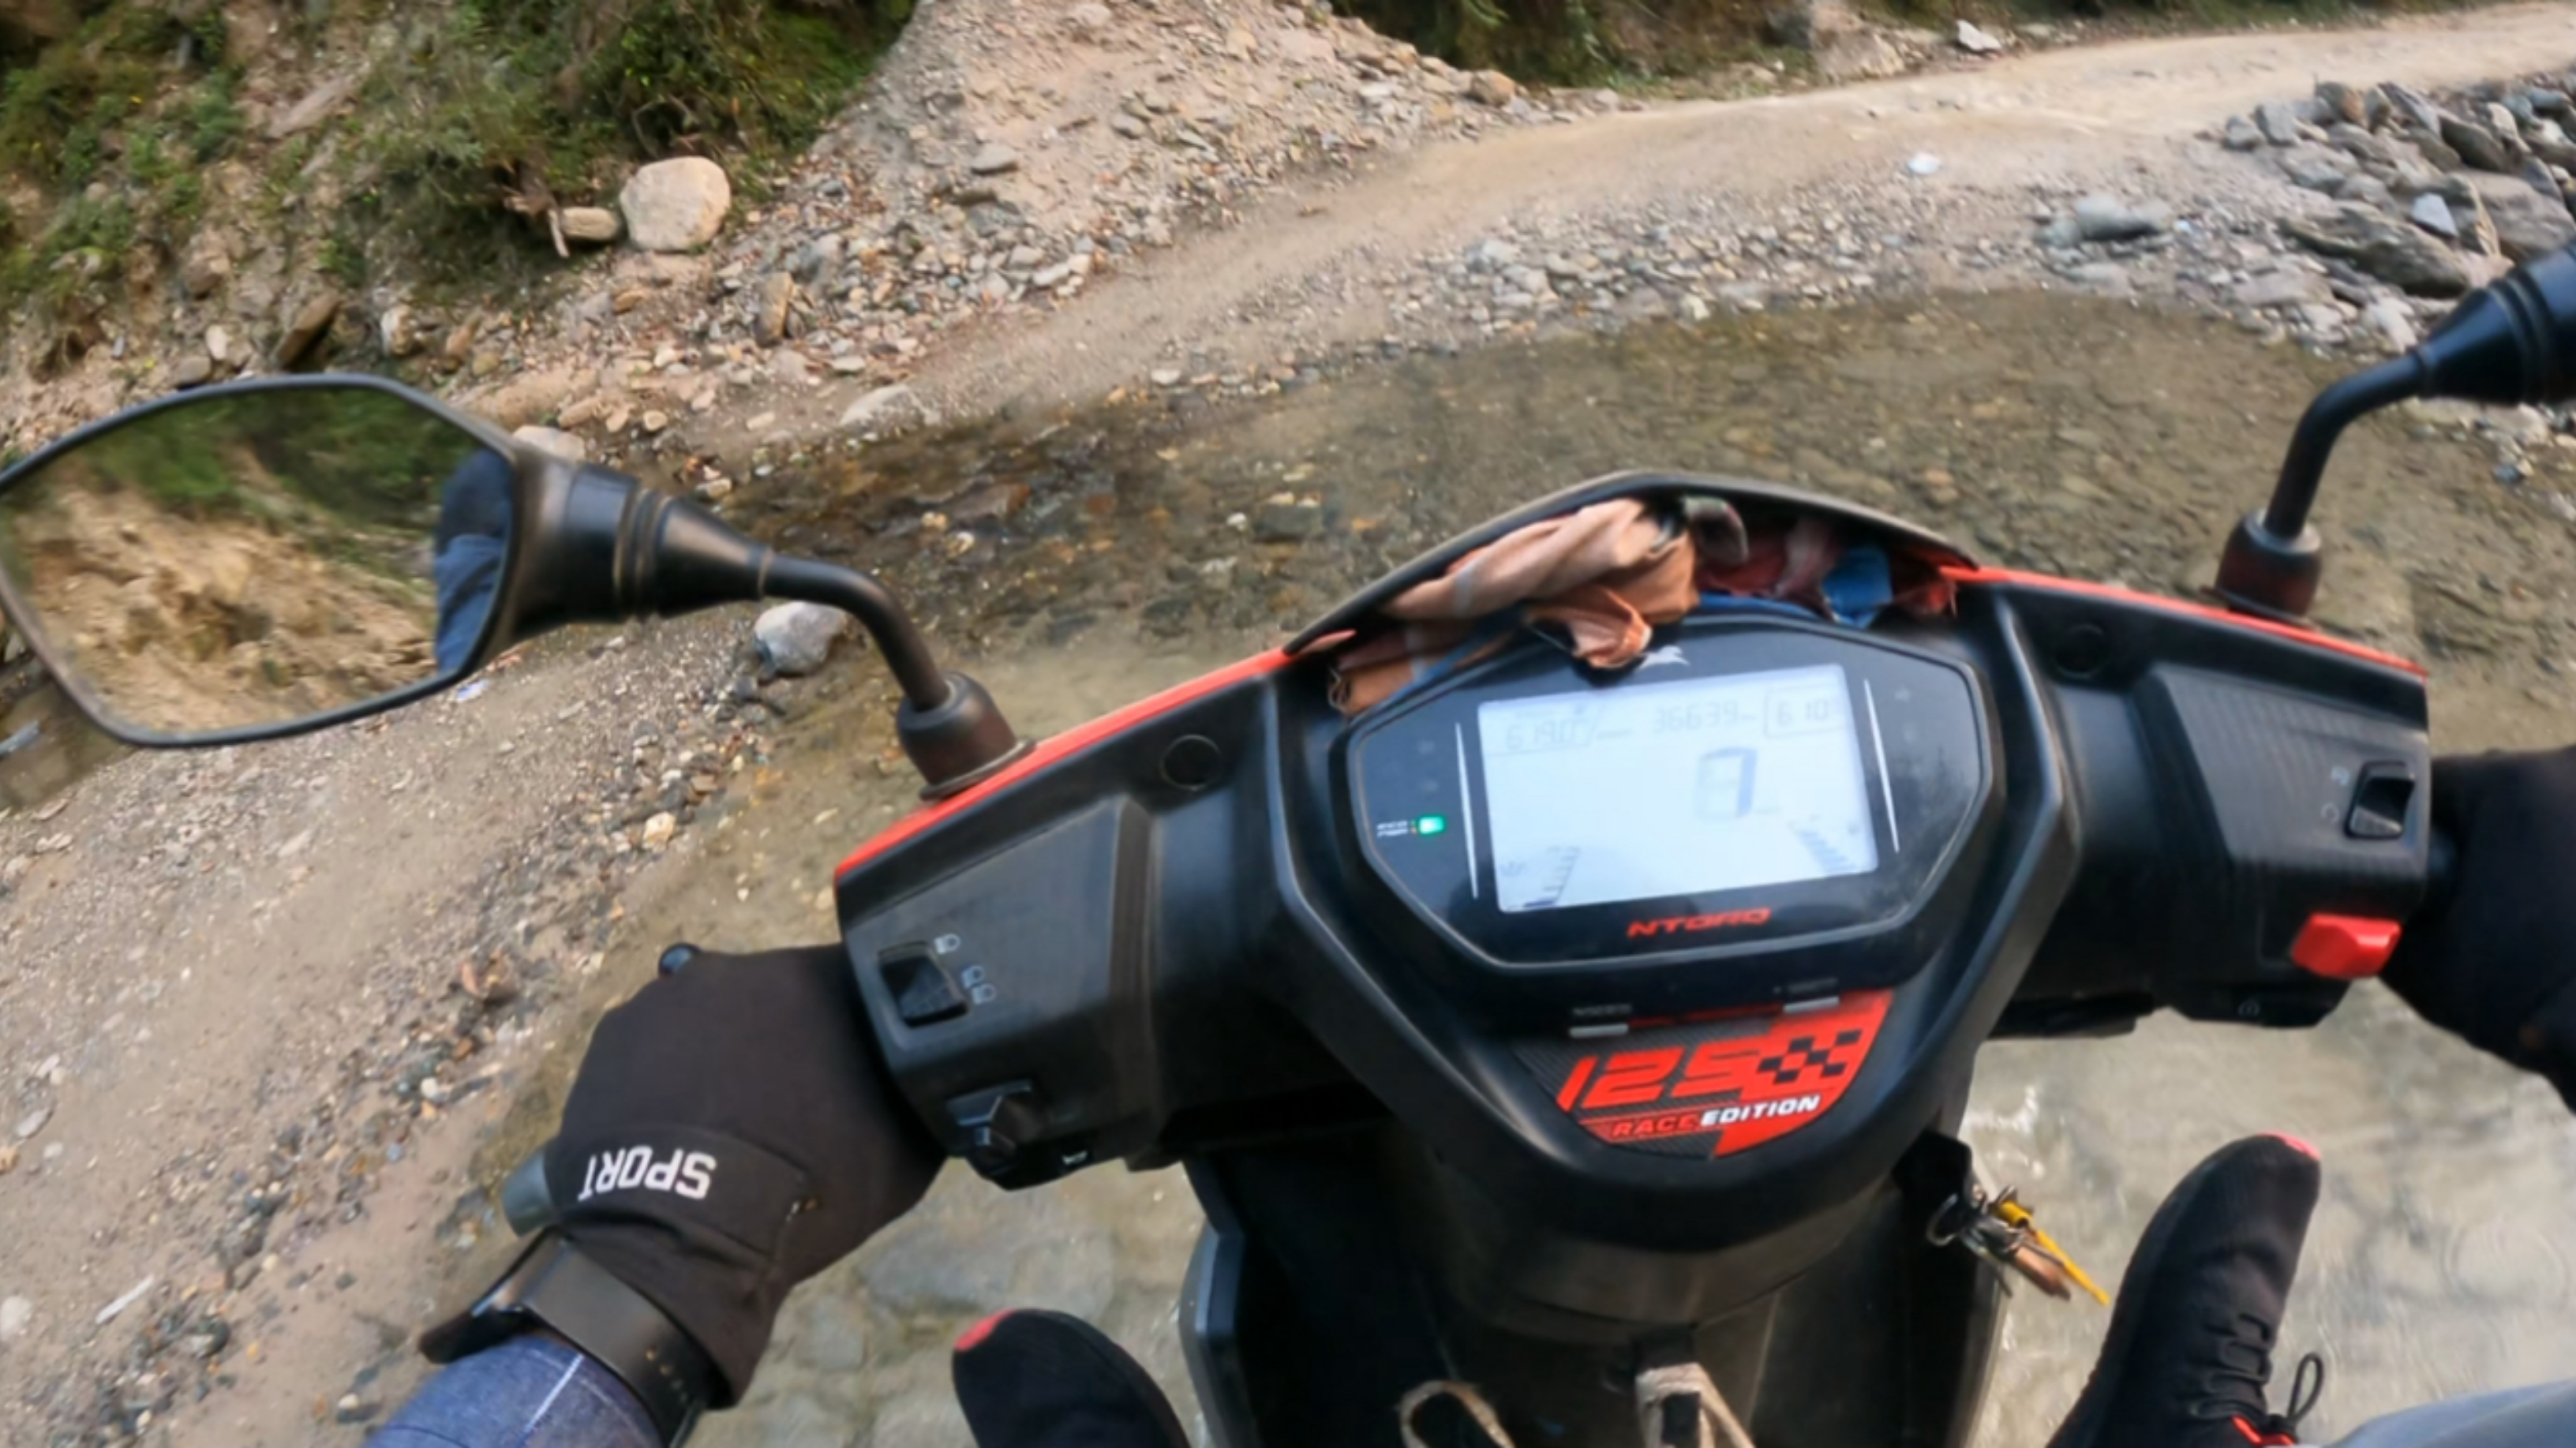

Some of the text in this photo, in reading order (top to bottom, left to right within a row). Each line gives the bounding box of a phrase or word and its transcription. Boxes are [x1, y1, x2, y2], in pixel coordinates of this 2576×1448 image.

[1627, 907, 1771, 937] NTORQ
[1556, 1040, 1760, 1113] 125
[1612, 1094, 1821, 1138] RACE EDITION
[578, 1144, 717, 1202] SPORT
